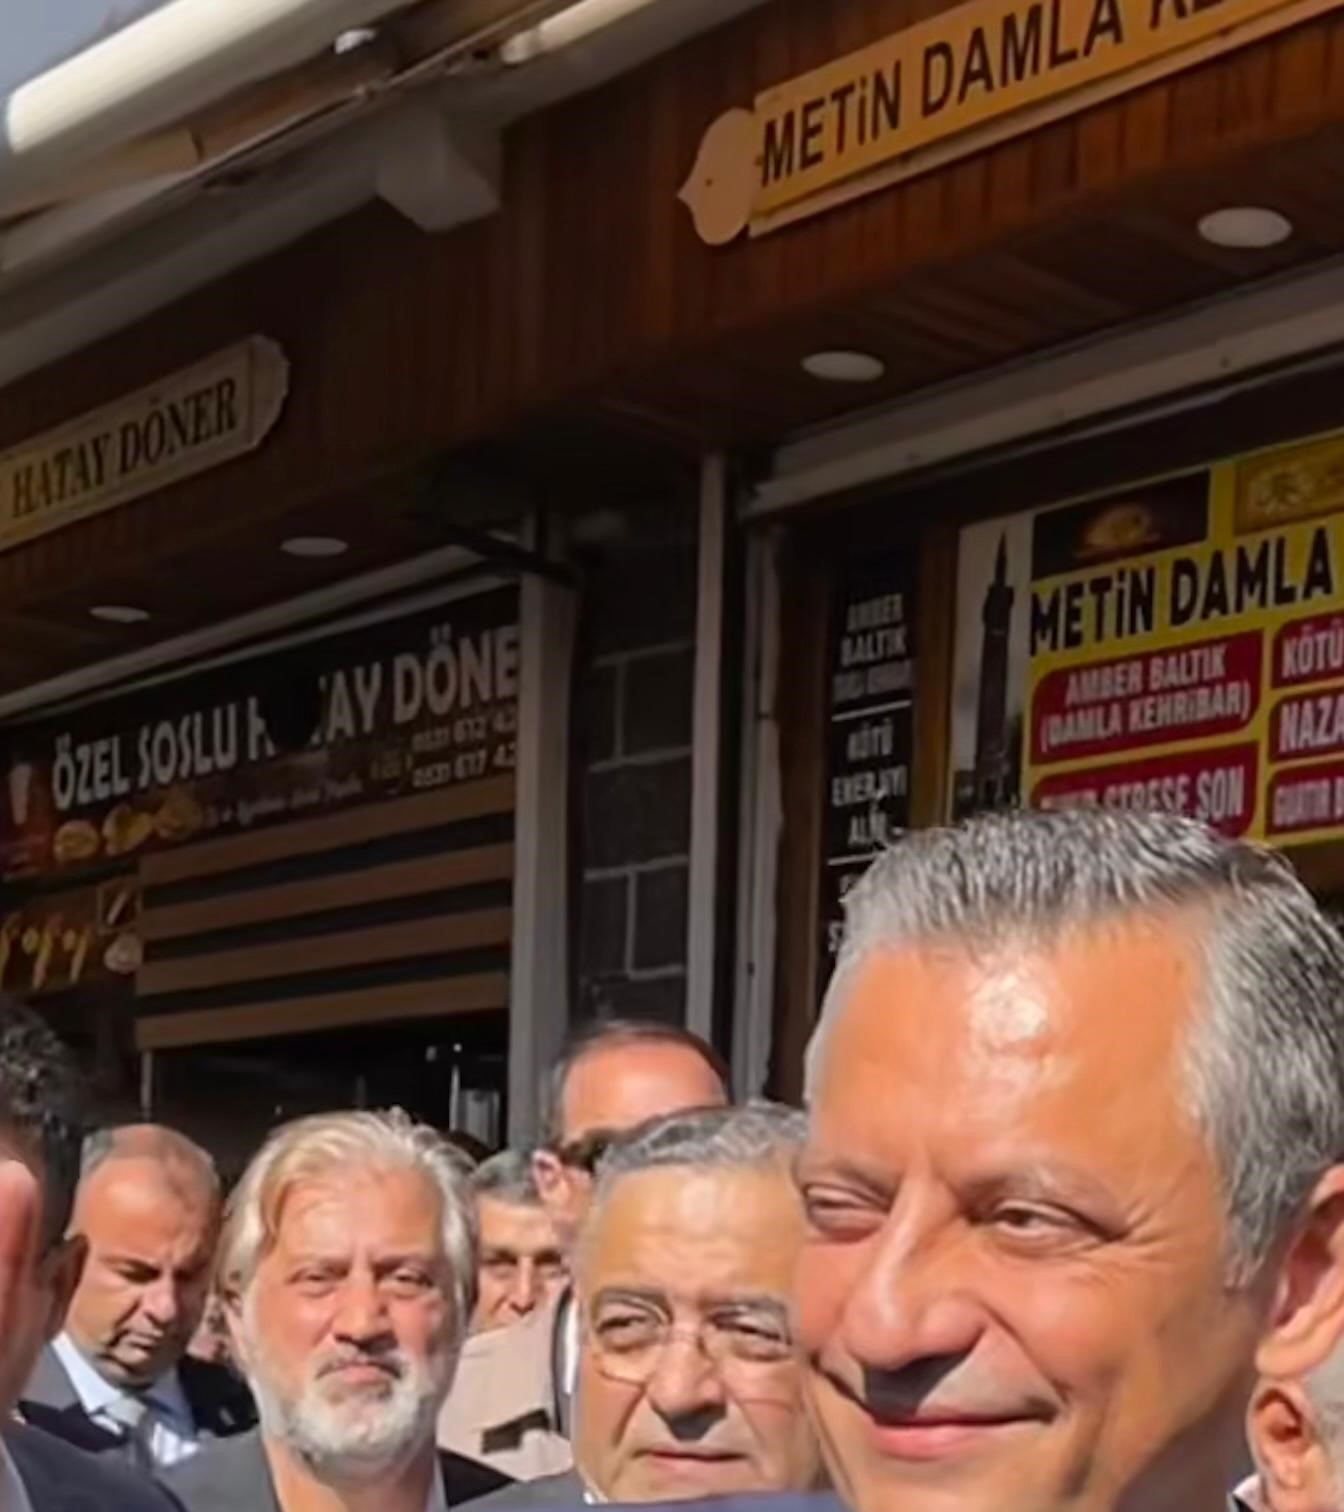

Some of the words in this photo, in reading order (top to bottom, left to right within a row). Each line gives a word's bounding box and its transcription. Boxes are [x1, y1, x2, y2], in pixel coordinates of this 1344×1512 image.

[760, 60, 902, 188] METİN
[920, 0, 1124, 119] DAMLA
[12, 432, 116, 518] HATAY
[118, 377, 237, 476] DÖNER
[1029, 565, 1156, 657] METİN
[1169, 527, 1334, 627] DAMLA
[1064, 660, 1144, 707] AMBER
[1148, 644, 1228, 691] BALTIK
[51, 732, 131, 811] ÖZEL
[138, 701, 238, 790] SOSLU
[1194, 764, 1245, 822] SON
